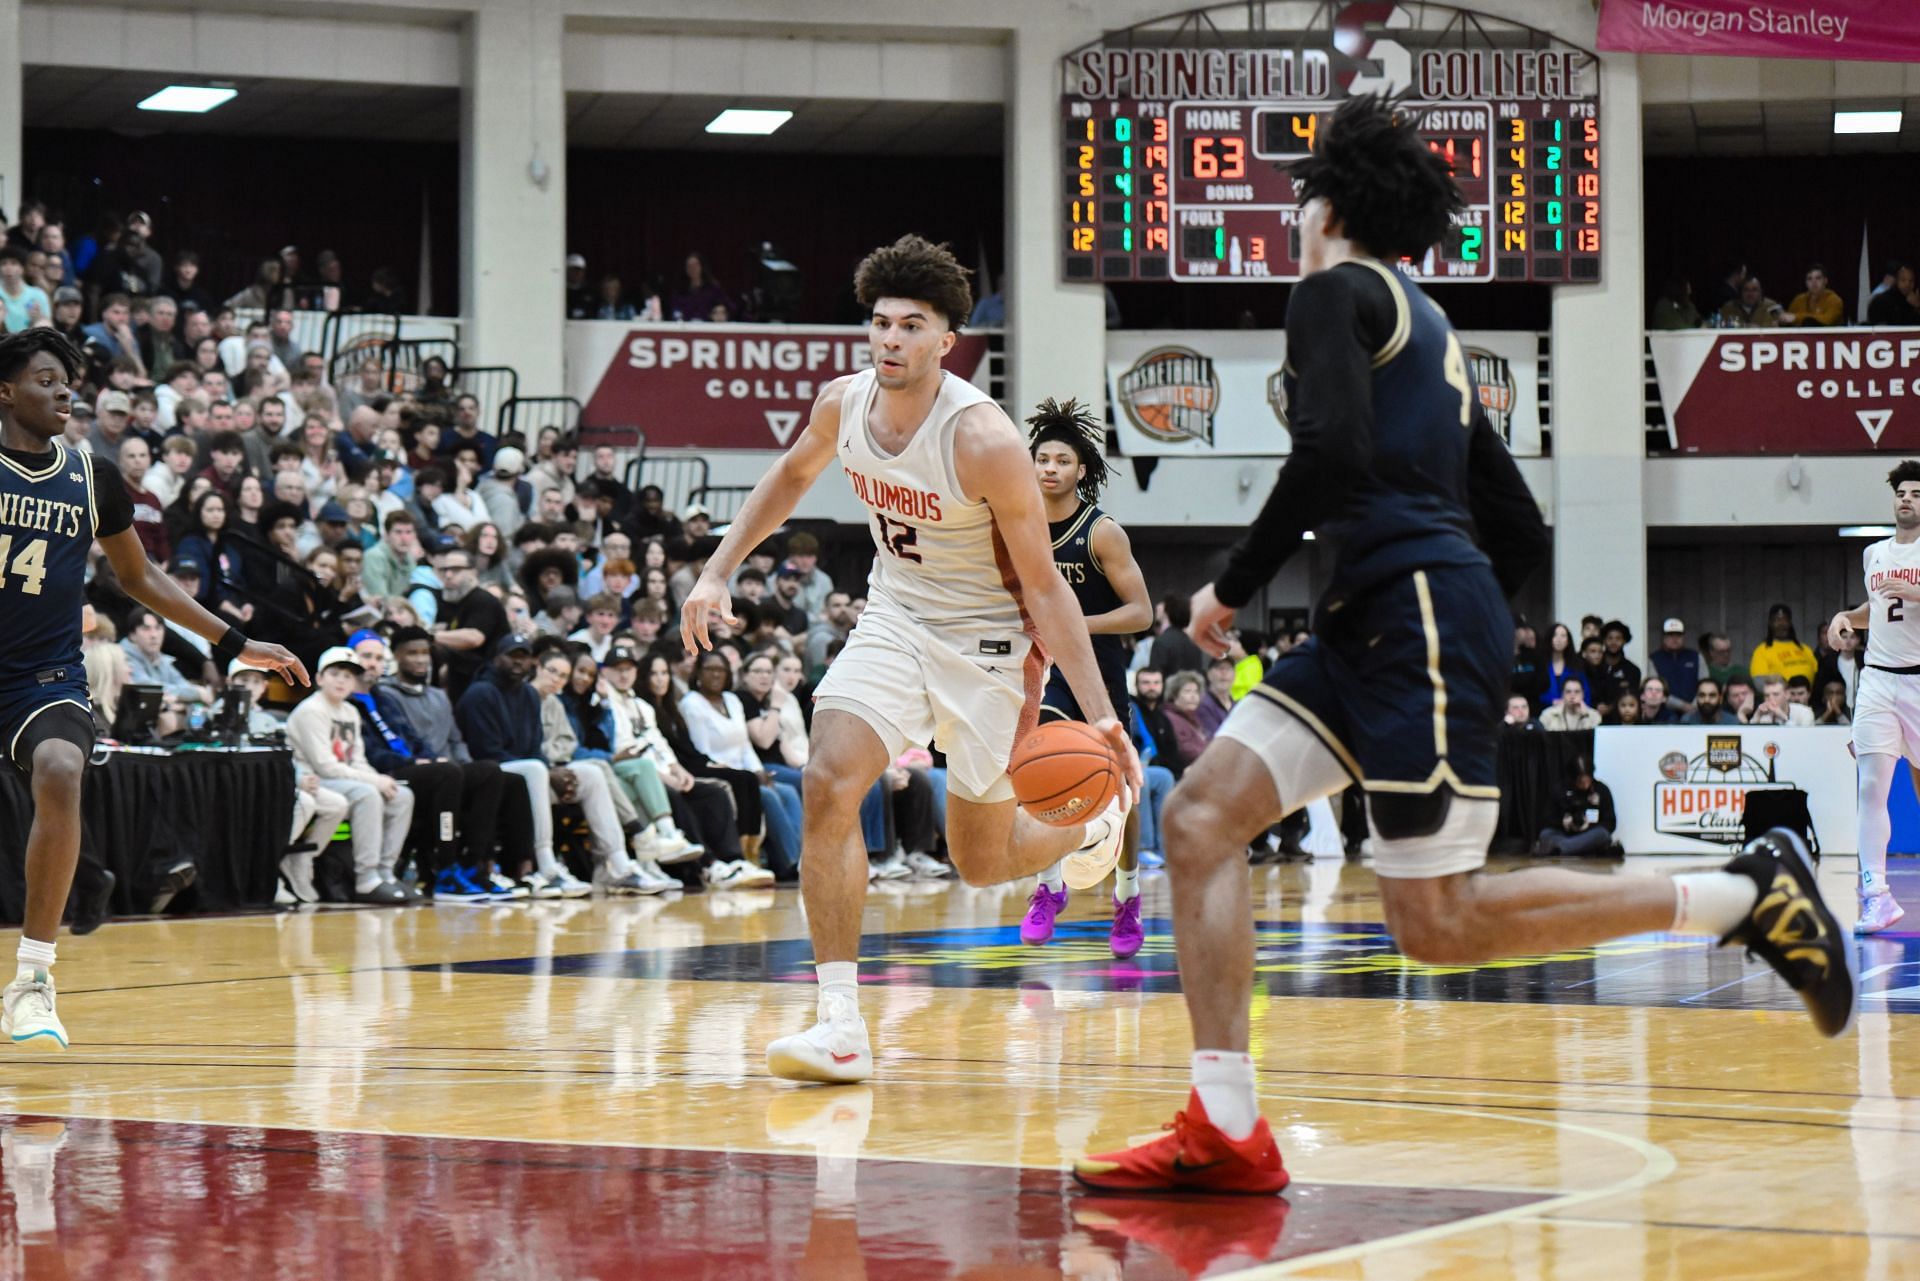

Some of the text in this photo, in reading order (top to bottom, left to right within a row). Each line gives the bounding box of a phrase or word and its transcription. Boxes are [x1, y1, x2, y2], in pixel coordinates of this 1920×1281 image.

[1642, 2, 1848, 42] Morgan Stanley
[1079, 48, 1330, 100] SPRINGFIELD
[1419, 49, 1583, 100] COLLEGE
[1071, 102, 1165, 117] NO F PTS
[1185, 110, 1242, 130] HOME
[1501, 102, 1595, 117] NO F PTS
[1086, 118, 1168, 142] 1 0 3
[1511, 119, 1598, 142] 3 1 5
[1079, 145, 1168, 169] 2 1 19
[1193, 137, 1244, 178] 63
[1511, 146, 1598, 170] 4 2 4
[1079, 173, 1168, 197] 5 4 5
[1206, 184, 1254, 201] BONUS
[1511, 173, 1598, 197] 5 1 10
[1073, 201, 1168, 224] 11 1 17
[1180, 210, 1225, 226] FOULS
[1450, 211, 1482, 226] OULS
[1504, 201, 1598, 224] 12 0 2
[1073, 228, 1168, 251] 12 1 19
[1215, 227, 1224, 260] 1
[1251, 237, 1264, 260] 3
[1461, 227, 1482, 261] 2
[1504, 229, 1599, 251] 14 1 13
[1243, 262, 1270, 276] TOL
[628, 337, 873, 372] SPRINGFIE
[875, 512, 922, 565] 12
[1887, 596, 1904, 622] 2
[1663, 787, 1745, 816] HOOPH
